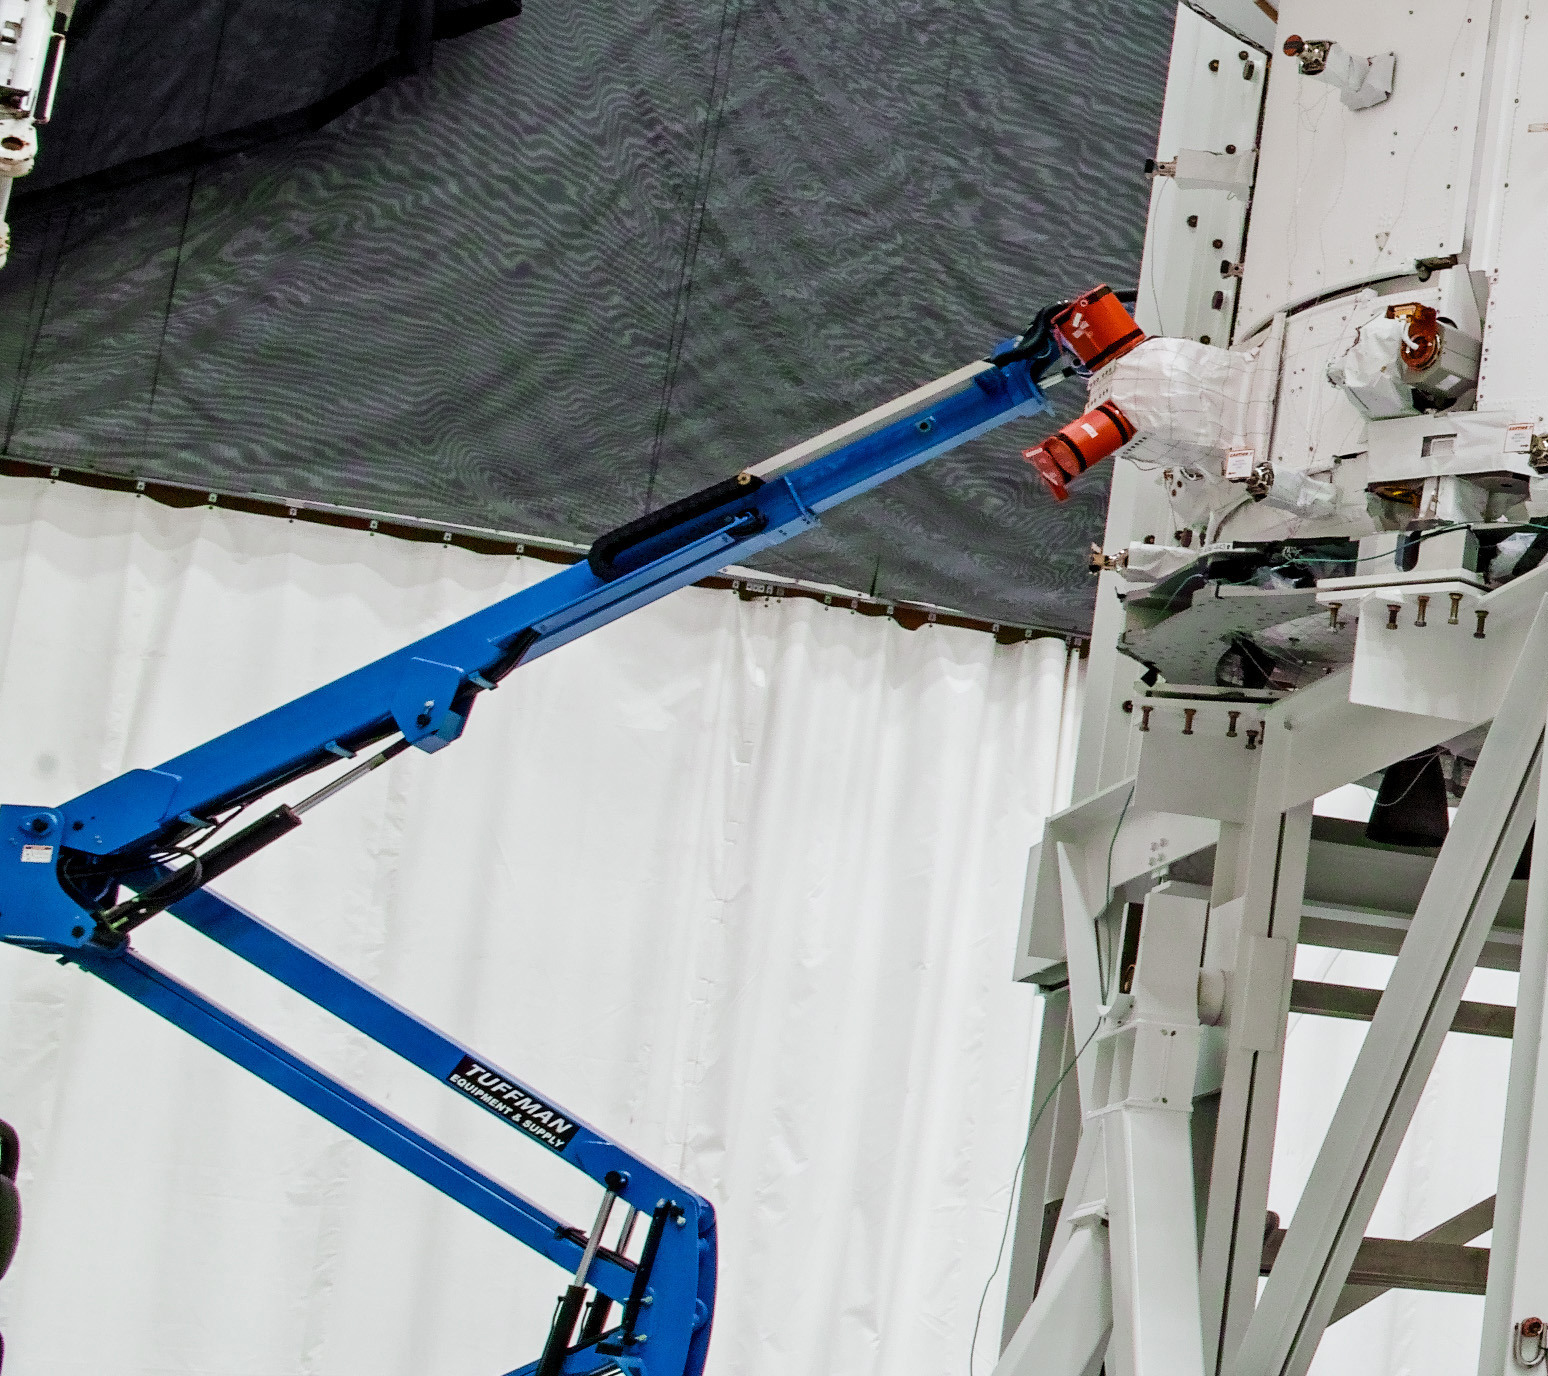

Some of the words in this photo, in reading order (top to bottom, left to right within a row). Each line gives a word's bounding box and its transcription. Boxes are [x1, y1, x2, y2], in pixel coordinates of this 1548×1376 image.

[450, 1073, 513, 1115] EQUIPMENT
[511, 1113, 522, 1122] &
[522, 1120, 565, 1148] SUPPLY
[466, 1063, 573, 1134] TUFFMAN
